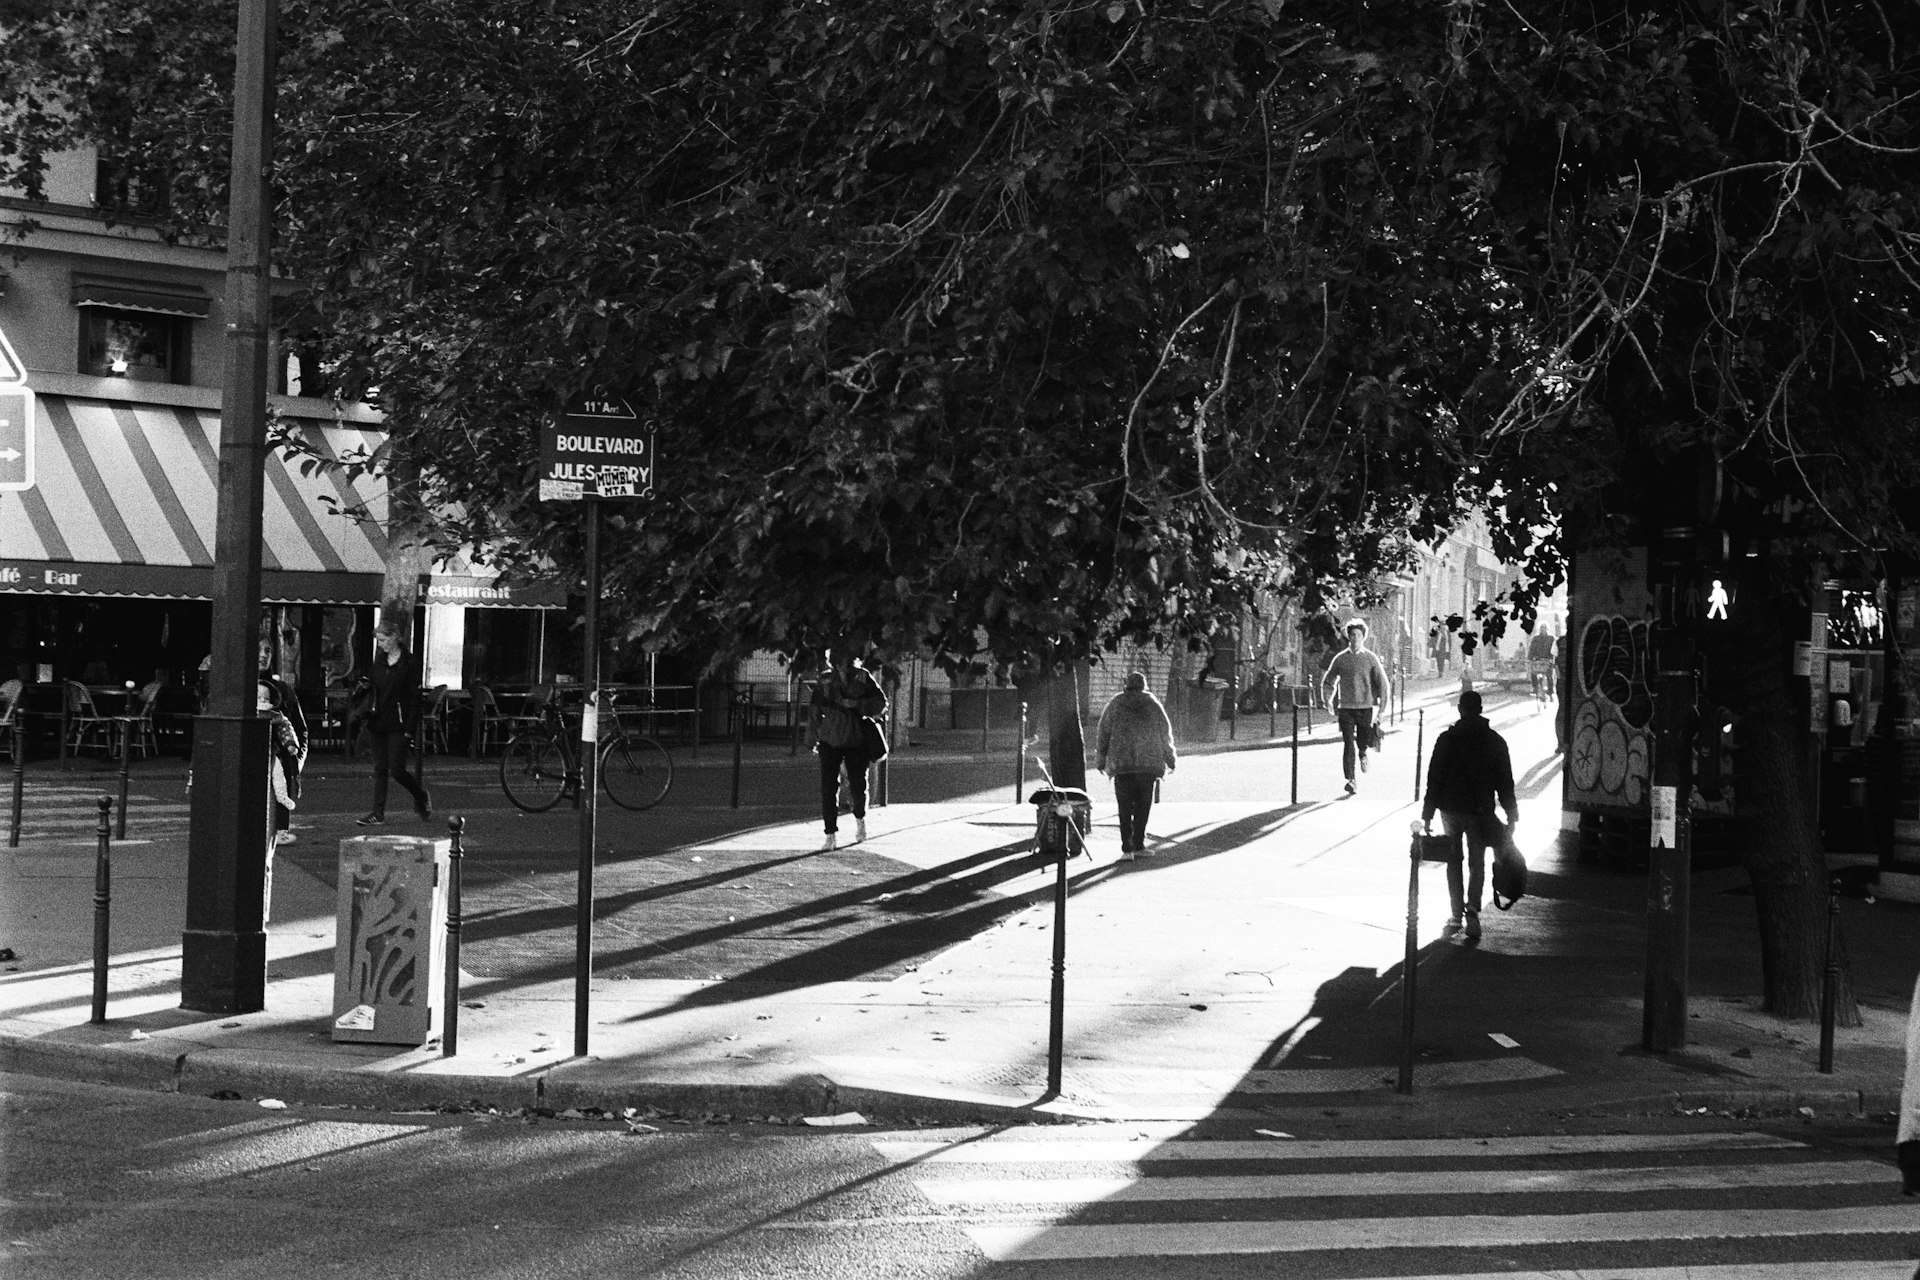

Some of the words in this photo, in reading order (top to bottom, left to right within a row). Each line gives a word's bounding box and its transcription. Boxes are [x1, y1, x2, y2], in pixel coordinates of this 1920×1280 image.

[556, 434, 644, 455] BOULEVARD
[549, 462, 595, 481] JULES
[605, 486, 627, 496] MTA
[0, 567, 21, 583] fé
[44, 569, 82, 585] Bar
[418, 583, 511, 599] Restaurant
